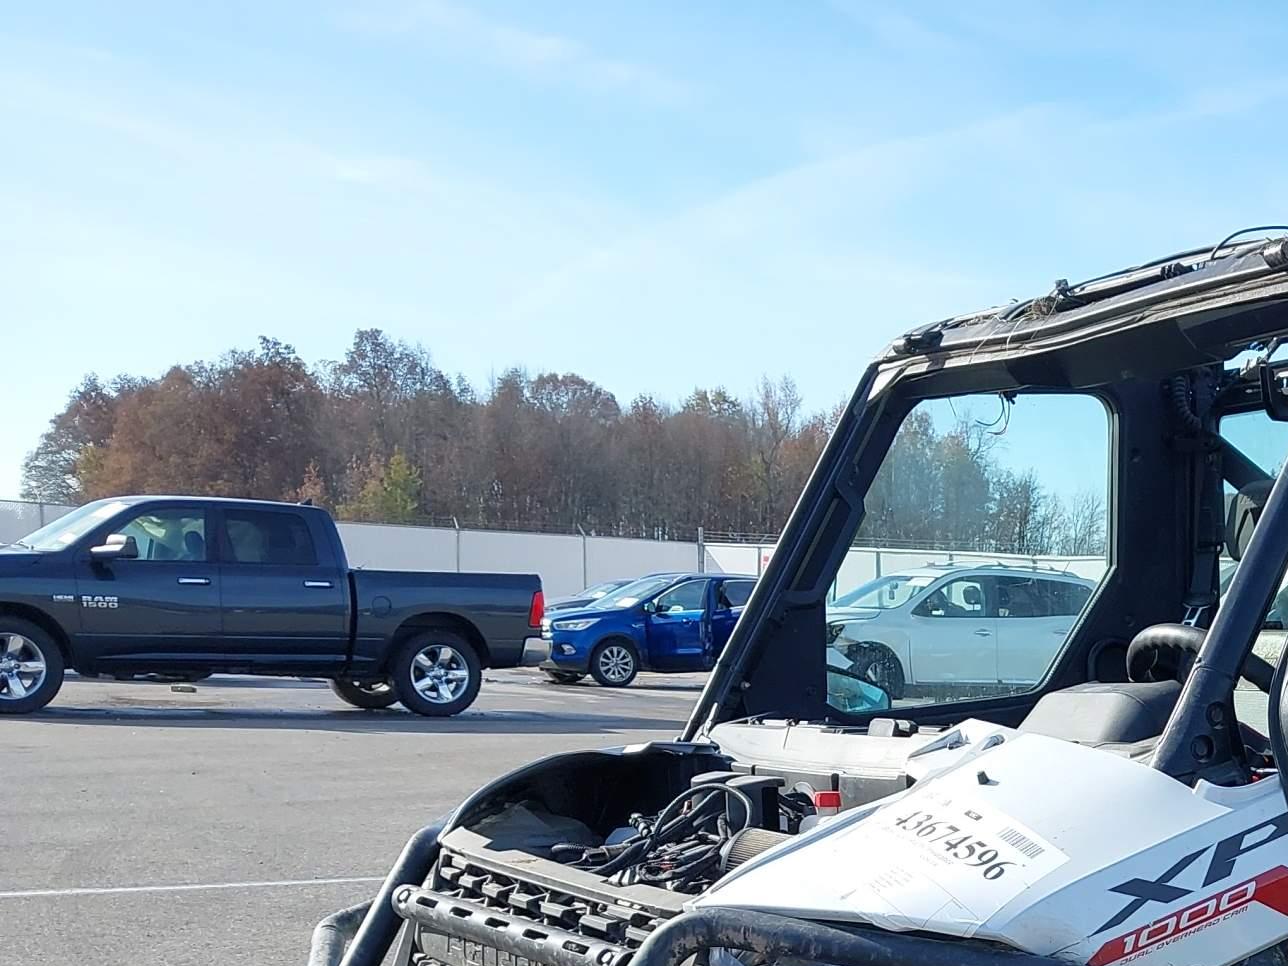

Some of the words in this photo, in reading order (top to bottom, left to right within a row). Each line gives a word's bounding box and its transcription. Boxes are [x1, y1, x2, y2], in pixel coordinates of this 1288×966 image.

[81, 601, 119, 609] 1500
[895, 810, 1018, 881] 43674596
[1119, 950, 1154, 966] DUAL
[1155, 918, 1221, 952] OVERHEAD
[1222, 904, 1249, 921] CAM
[1122, 879, 1258, 954] 1000
